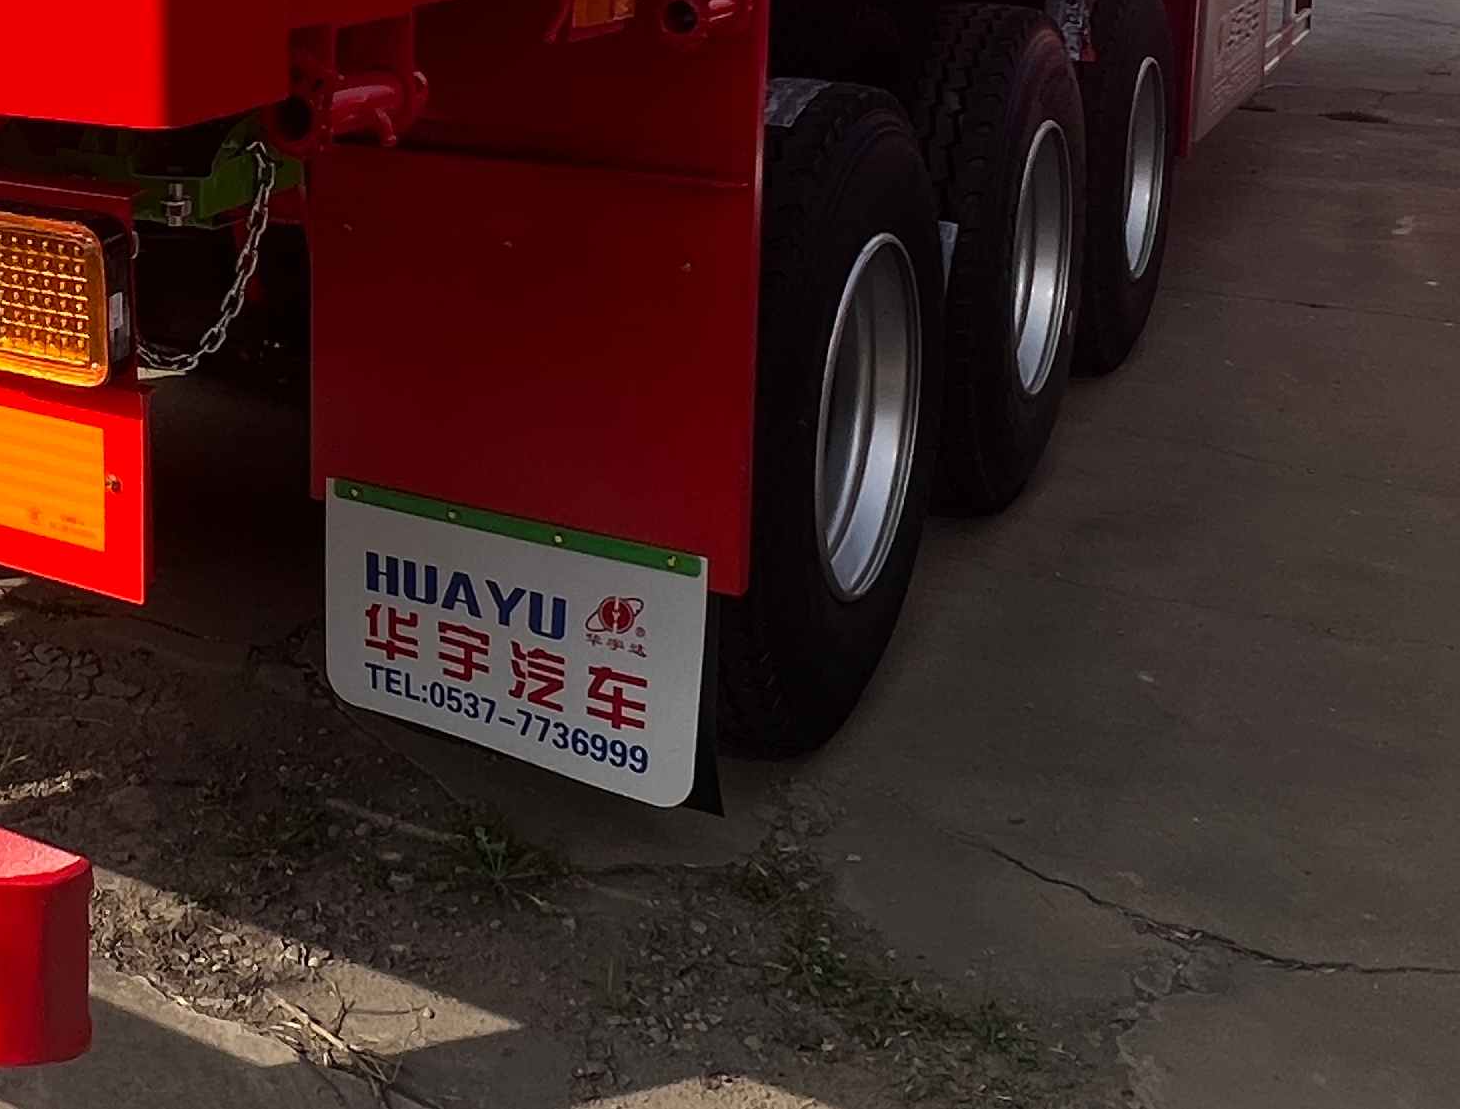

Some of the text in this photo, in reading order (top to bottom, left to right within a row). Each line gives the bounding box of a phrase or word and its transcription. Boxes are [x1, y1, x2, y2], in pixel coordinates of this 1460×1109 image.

[365, 551, 567, 640] HUAYU
[365, 603, 648, 730] 华宇汽车
[365, 662, 650, 774] TEL:0537-7736999
